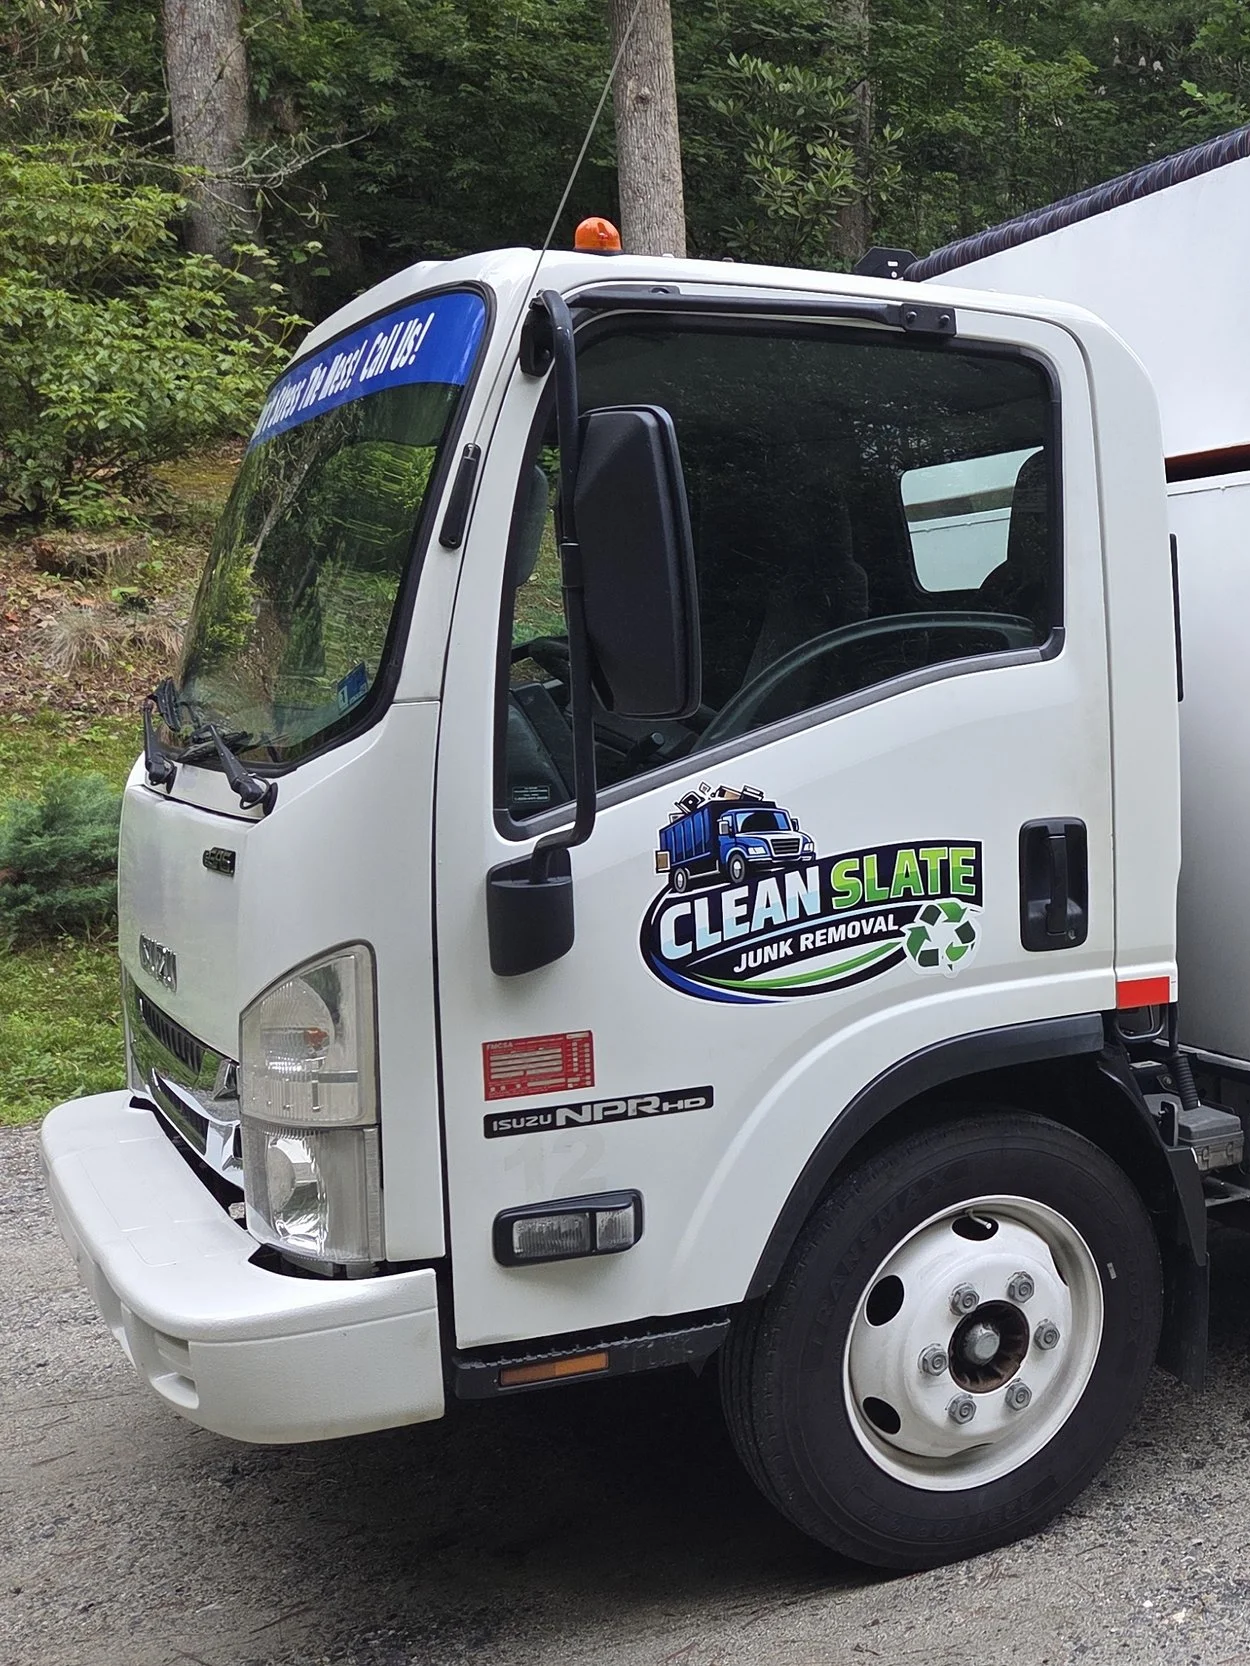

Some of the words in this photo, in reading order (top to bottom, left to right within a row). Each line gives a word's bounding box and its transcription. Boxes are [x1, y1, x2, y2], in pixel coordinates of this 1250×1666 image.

[359, 321, 404, 382] Call
[390, 312, 435, 371] Us!
[659, 867, 822, 961] CLEAN
[830, 846, 977, 910] SLATE
[733, 941, 793, 974] JUNK
[800, 914, 899, 951] REMOVAL
[493, 1114, 552, 1131] ISUZU
[556, 1096, 661, 1126] NPR
[662, 1097, 706, 1112] HD
